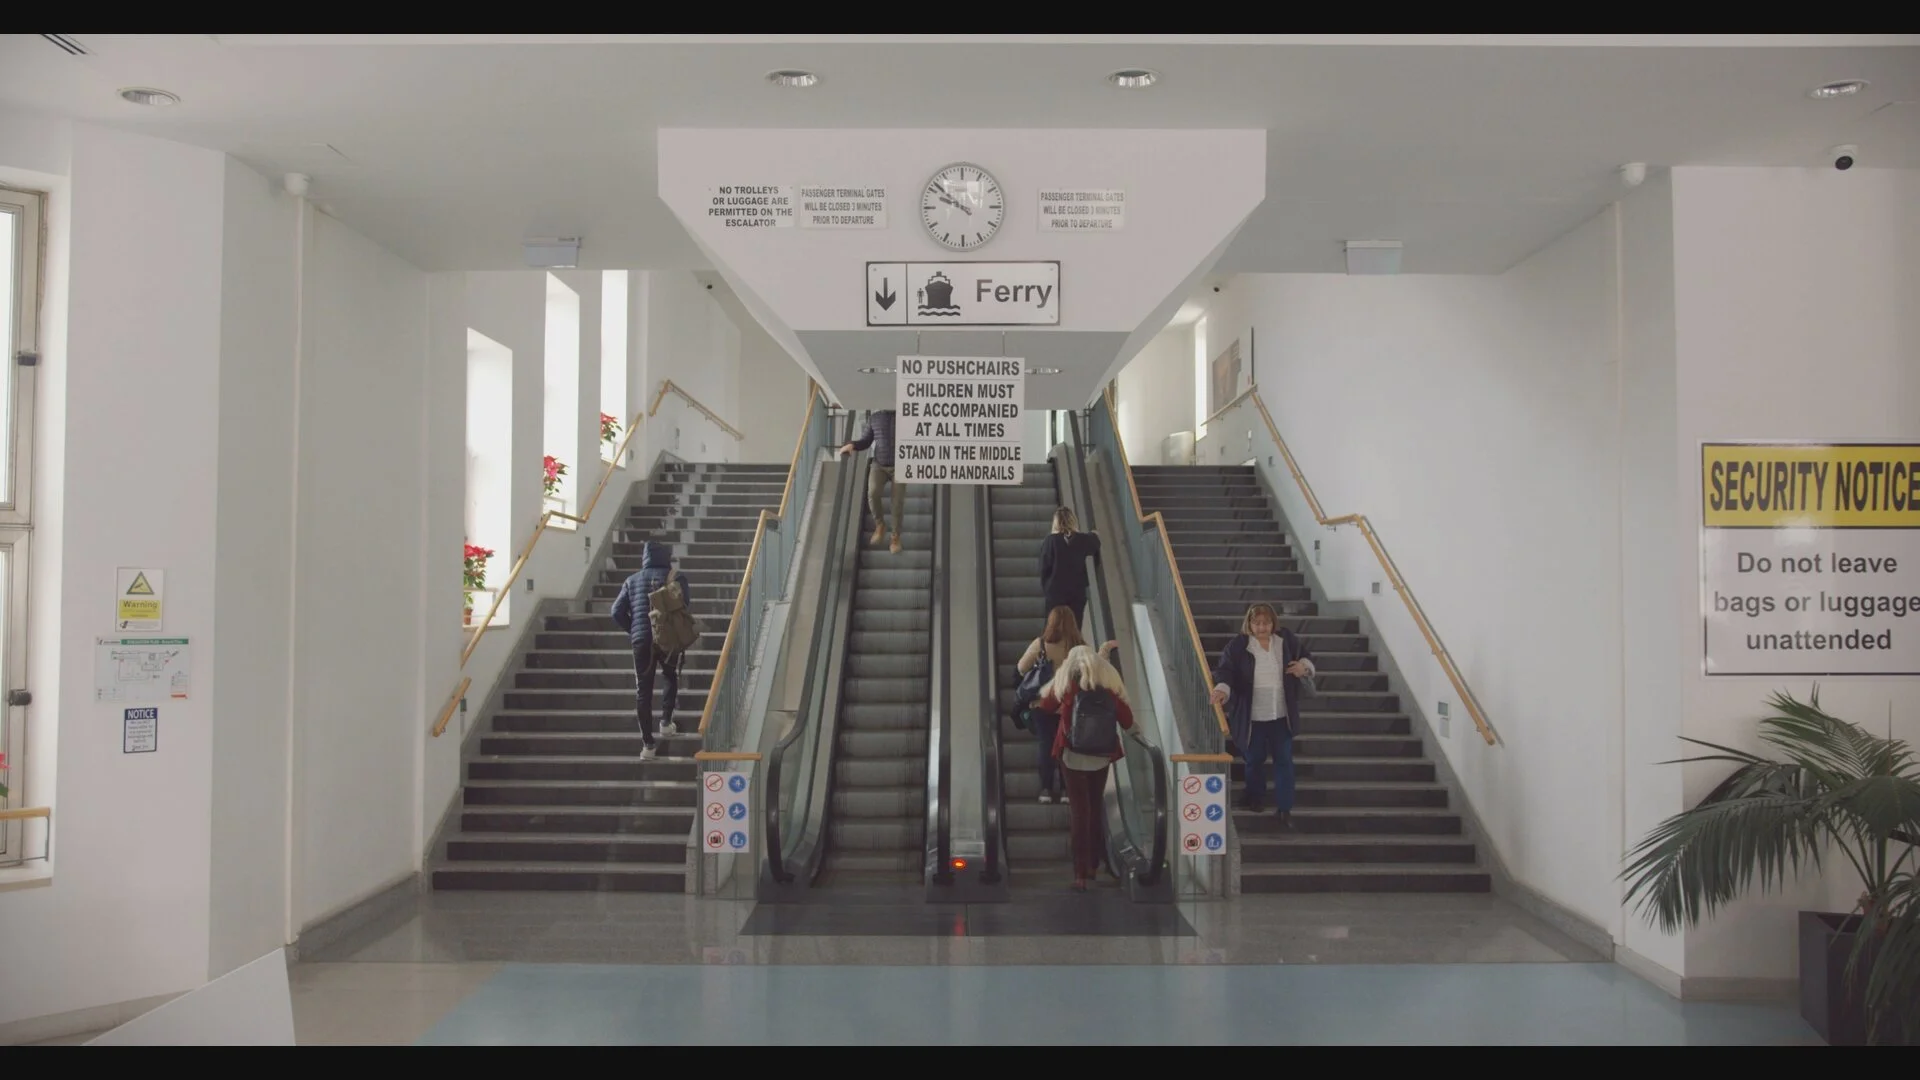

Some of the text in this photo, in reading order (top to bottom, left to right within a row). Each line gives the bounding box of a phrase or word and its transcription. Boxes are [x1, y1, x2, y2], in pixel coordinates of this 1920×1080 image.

[719, 186, 779, 195] NO TROLLEYS
[801, 188, 885, 198] PASSENGER TERMINAL GATES
[712, 197, 789, 205] OR LUGGAGE ARE
[1040, 192, 1124, 201] PASSENGER TERMINAL GATES
[804, 202, 818, 211] WILL
[819, 202, 829, 211] BE
[829, 202, 850, 211] CLOSED
[856, 202, 882, 211] MINUTES
[1043, 206, 1057, 215] WILL
[1058, 206, 1066, 215] BE
[1067, 206, 1090, 215] CLOSED
[708, 208, 793, 216] PERMITTED ON THE
[725, 219, 776, 227] ESCALATOR
[812, 216, 874, 224] PRIOR TO DEPARTURE
[1051, 219, 1113, 228] PRIOR TO DEPARTURE
[976, 279, 1052, 309] Ferry
[902, 360, 1020, 376] NO PUSHCHAIRS
[906, 383, 1014, 398] CHILDREN MUST
[902, 403, 1018, 418] BE ACCOMPANIED
[915, 422, 1005, 437] AT ALL TIMES
[899, 445, 1021, 461] STAND IN THE MIDDLE
[905, 464, 1014, 480] & HOLD HANDRAILS
[1710, 460, 1920, 511] SECURITY NOTICE
[1738, 552, 1897, 573] Do not leave
[123, 600, 158, 610] Warning
[1714, 591, 1920, 617] bags or luggage
[1747, 629, 1892, 650] unattended
[128, 709, 154, 719] NOTICE
